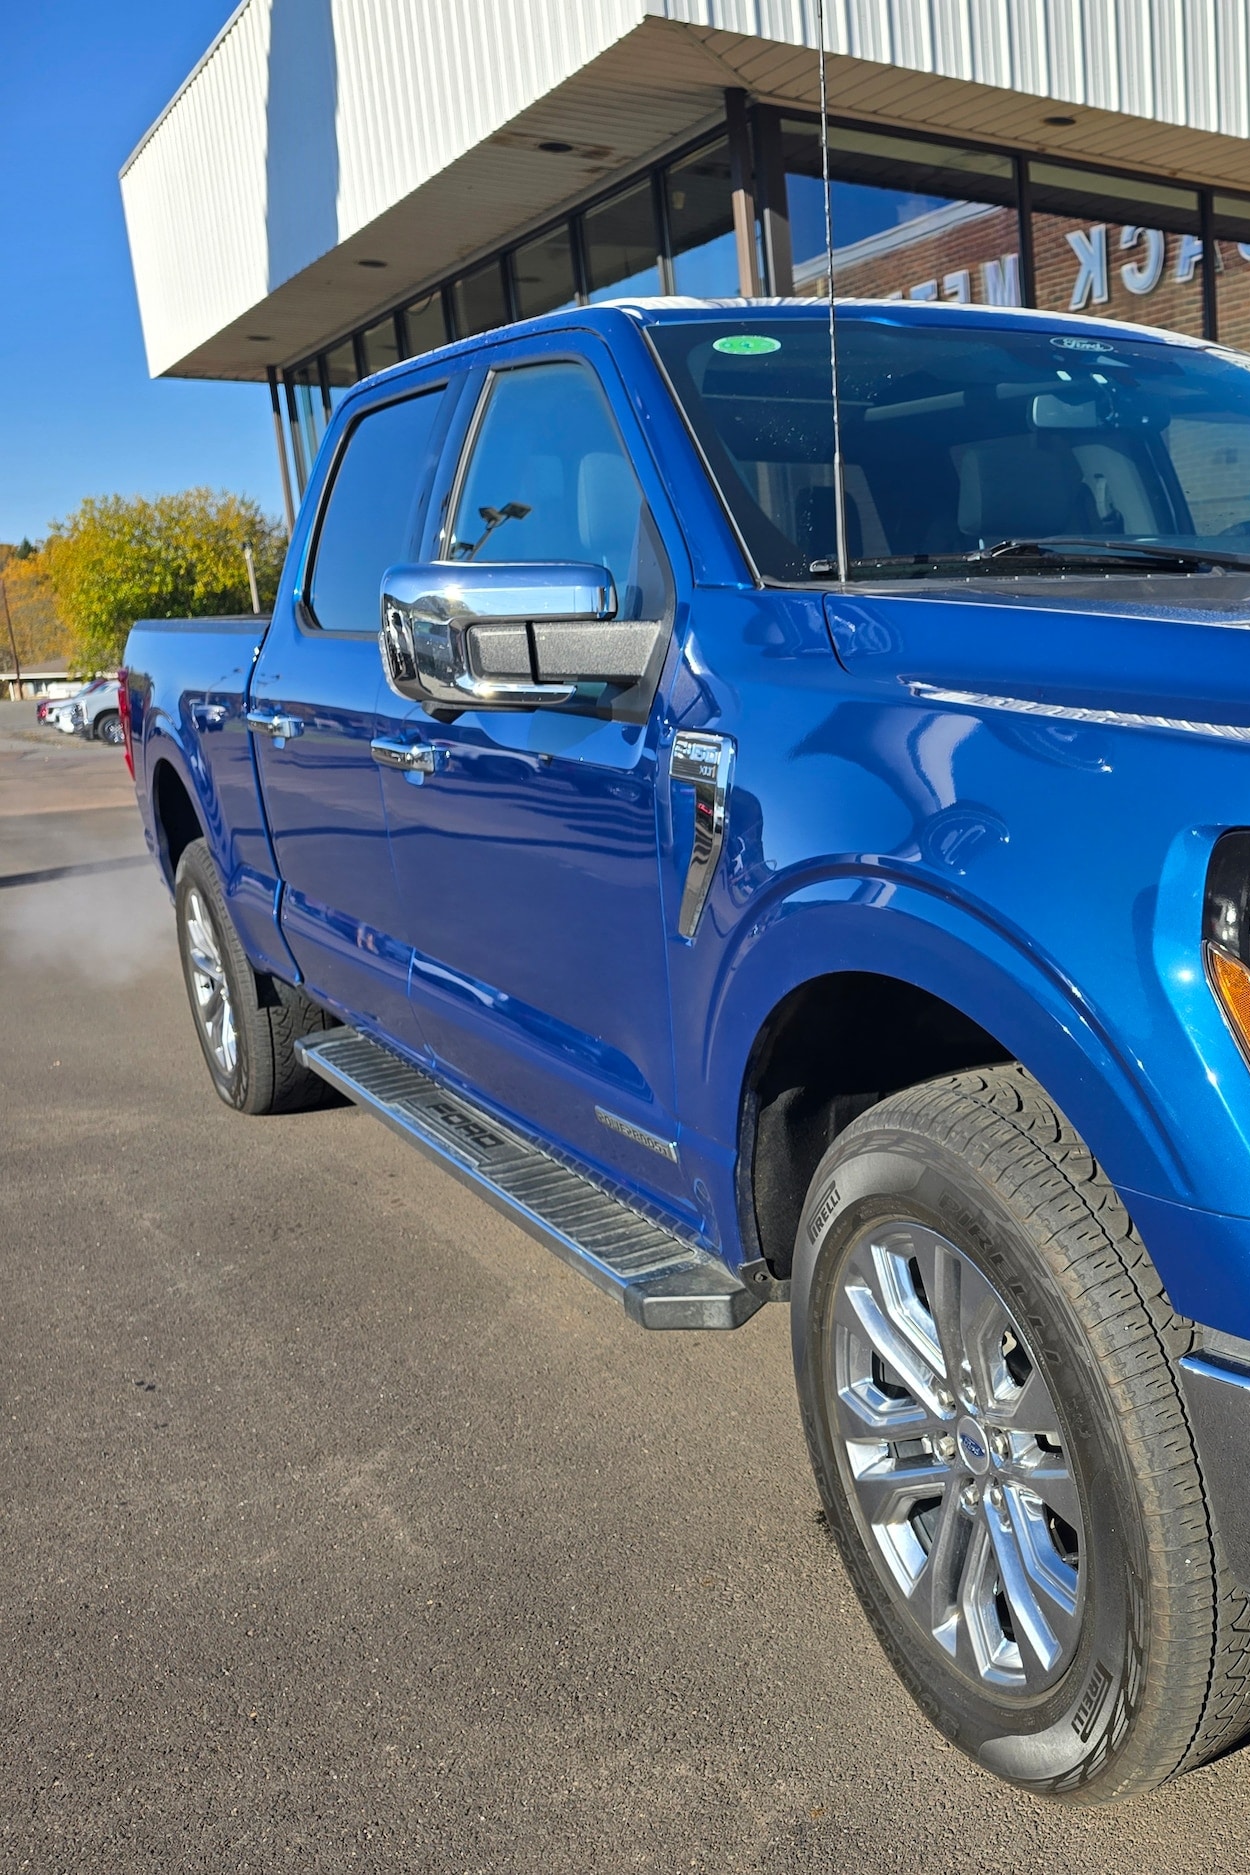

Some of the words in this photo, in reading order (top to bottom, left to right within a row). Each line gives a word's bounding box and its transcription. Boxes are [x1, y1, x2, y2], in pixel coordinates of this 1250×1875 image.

[426, 1102, 505, 1149] FORD
[807, 1180, 841, 1245] PIRELLI
[937, 1192, 1061, 1364] PIRELLI
[1070, 1660, 1114, 1743] PIRELLI
